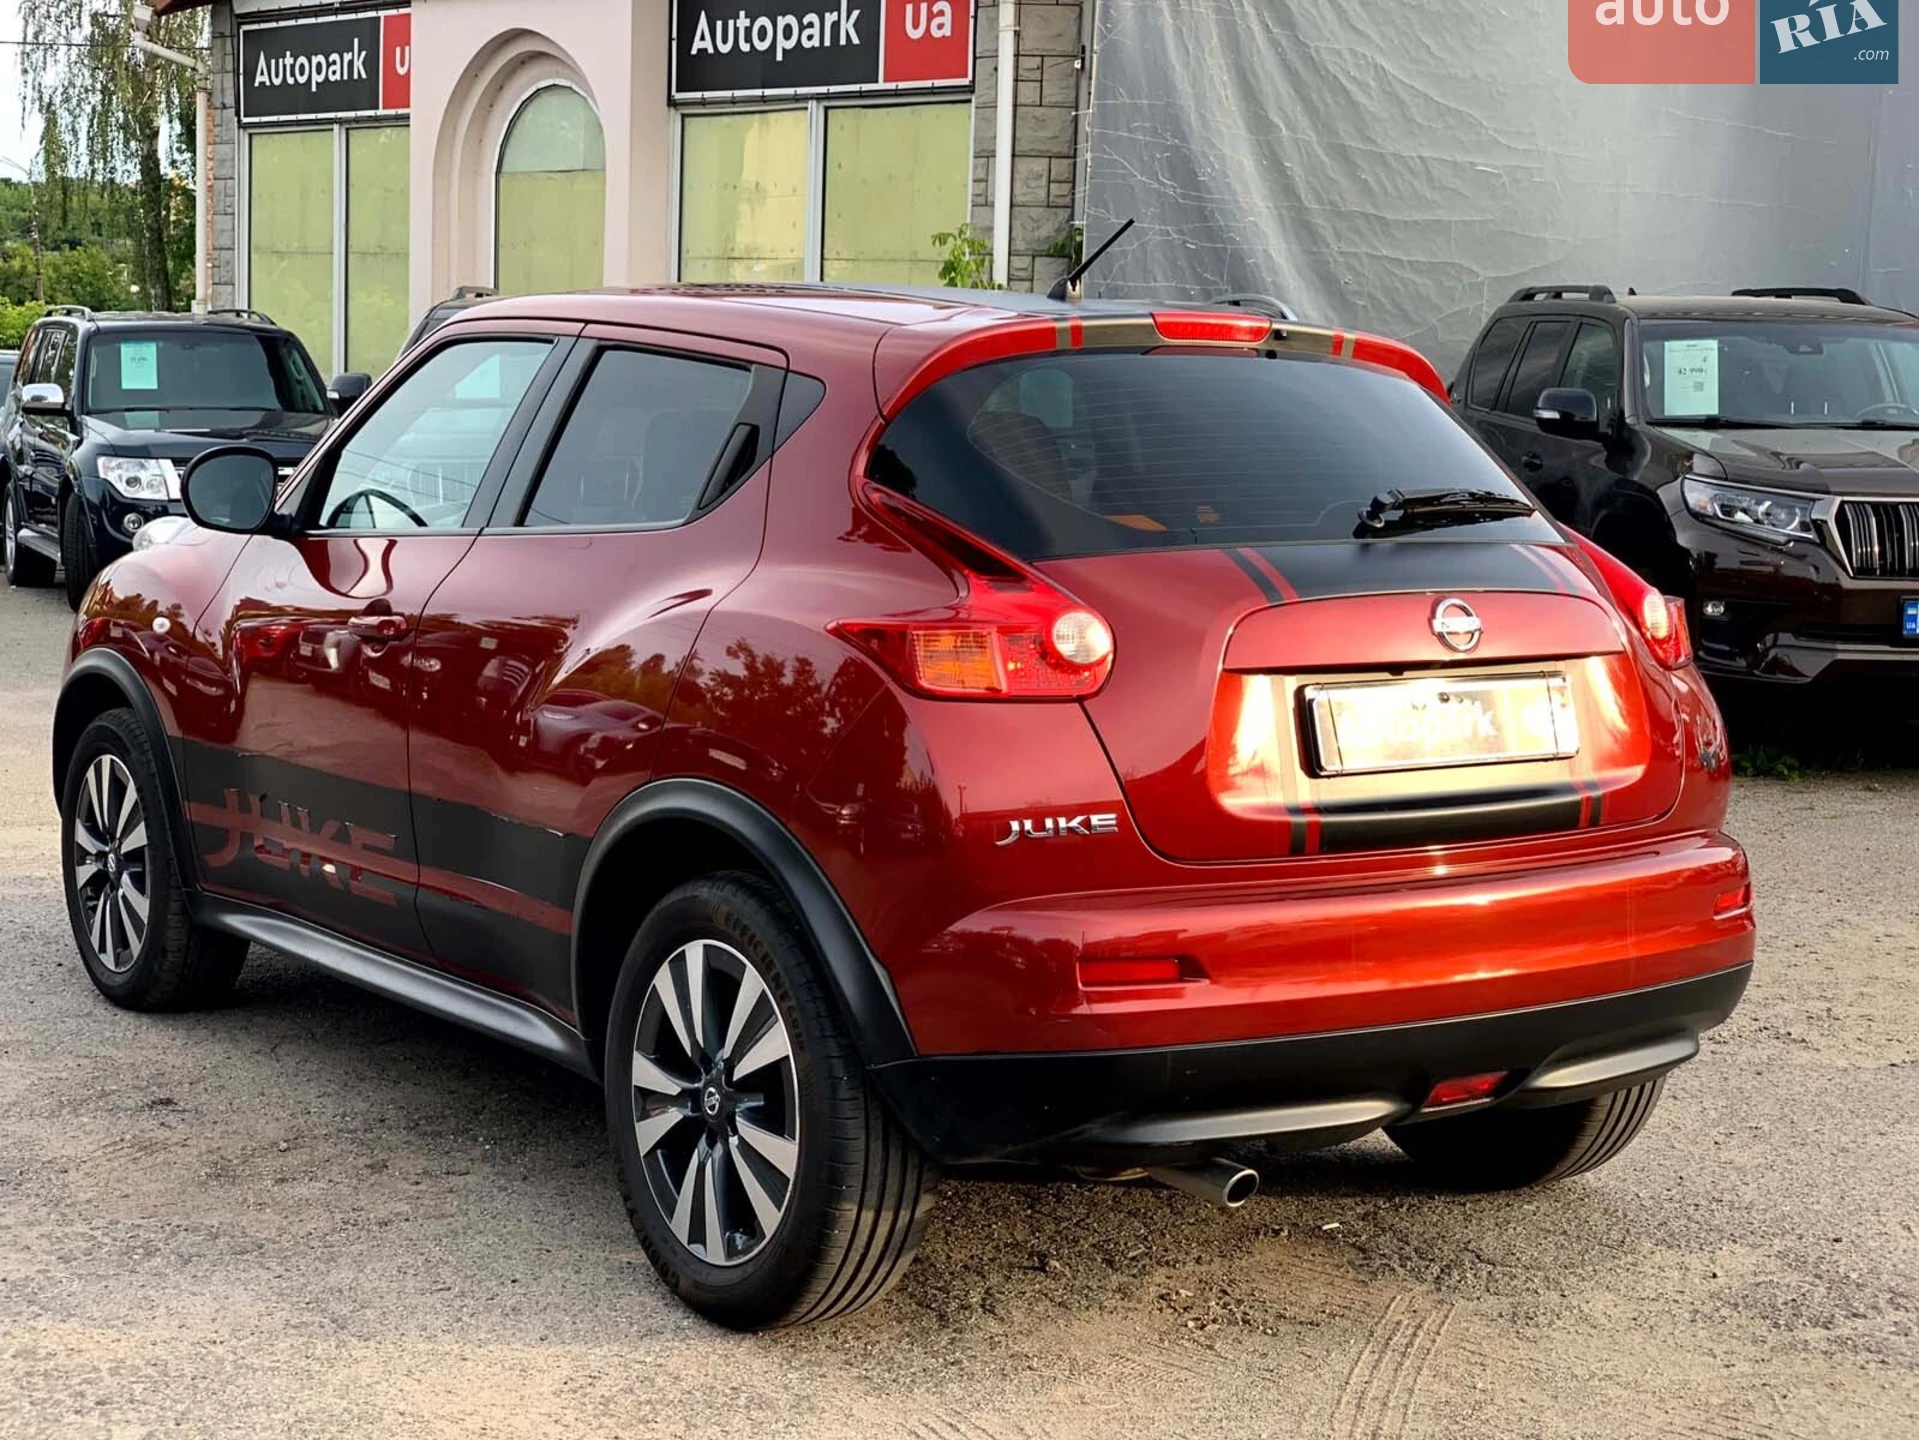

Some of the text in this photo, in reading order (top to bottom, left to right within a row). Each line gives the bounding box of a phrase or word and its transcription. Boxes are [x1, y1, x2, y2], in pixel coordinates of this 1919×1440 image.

[690, 0, 952, 62] Autopark ua
[254, 37, 368, 92] Autopark
[203, 788, 398, 907] JUKE
[995, 802, 1119, 847] JUKE
